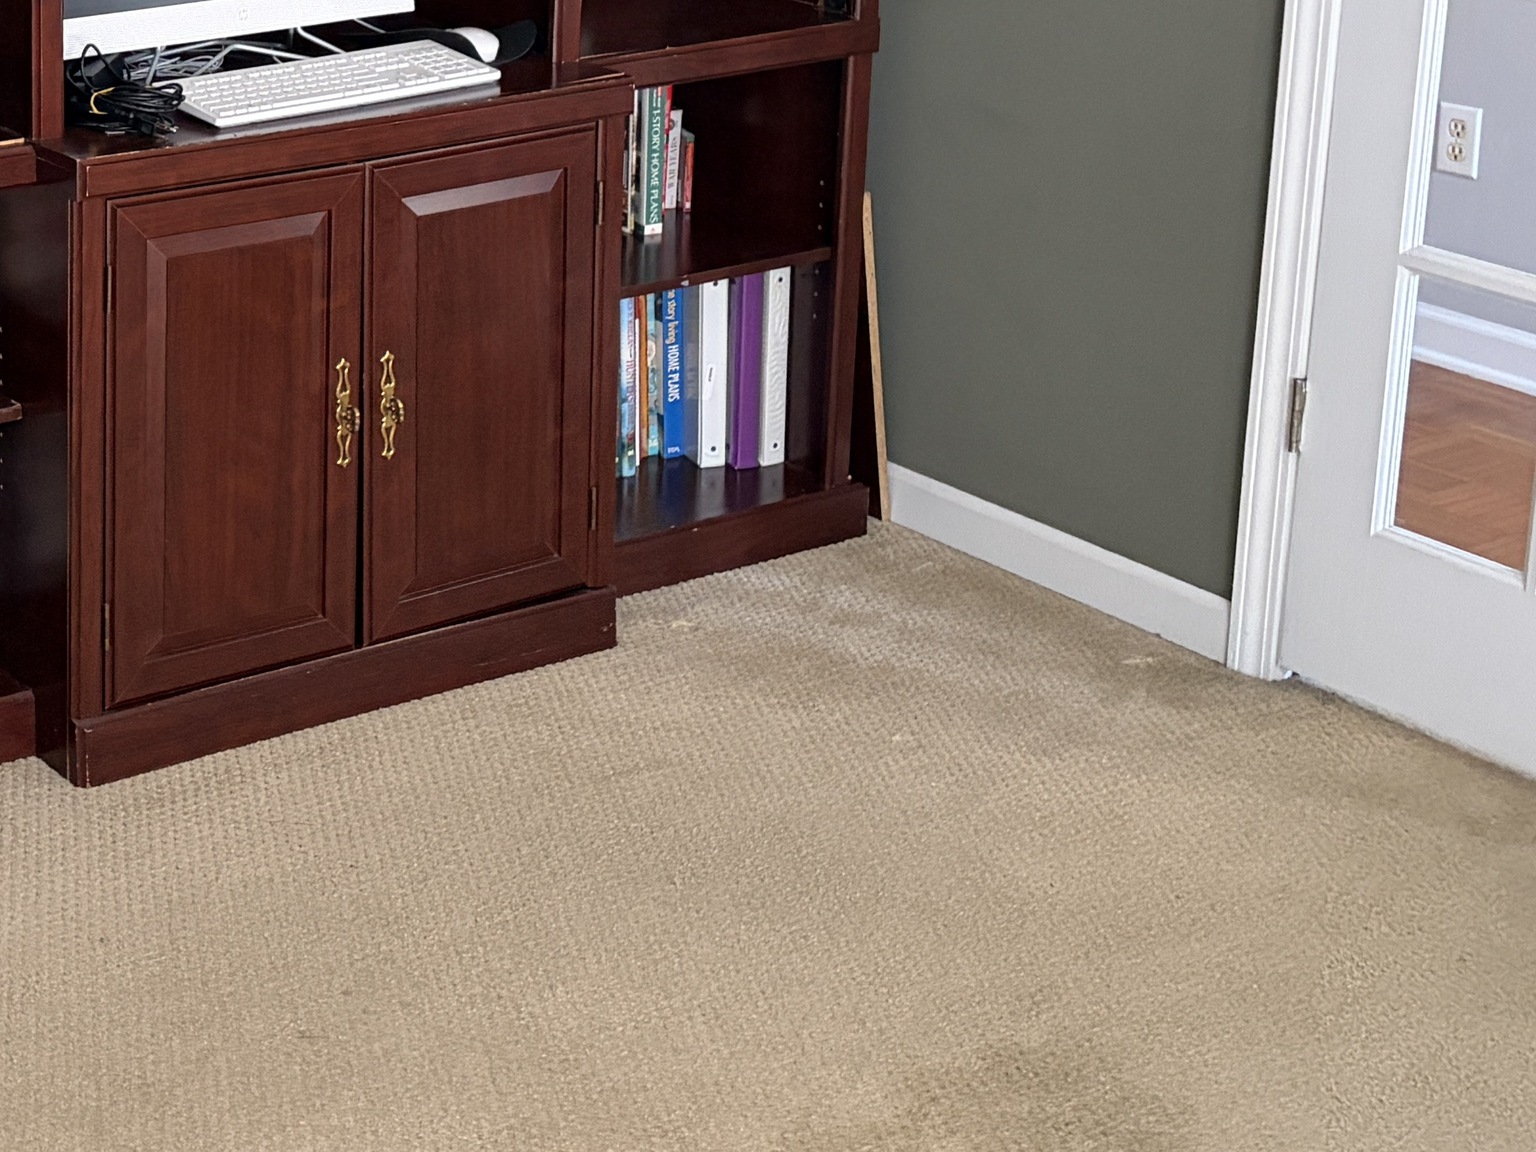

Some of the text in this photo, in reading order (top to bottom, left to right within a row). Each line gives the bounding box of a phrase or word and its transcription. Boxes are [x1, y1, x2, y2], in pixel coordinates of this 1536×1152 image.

[649, 152, 659, 186] HOME
[648, 189, 659, 223] PLANS
[667, 344, 679, 372] HOME
[667, 373, 680, 402] PLANS
